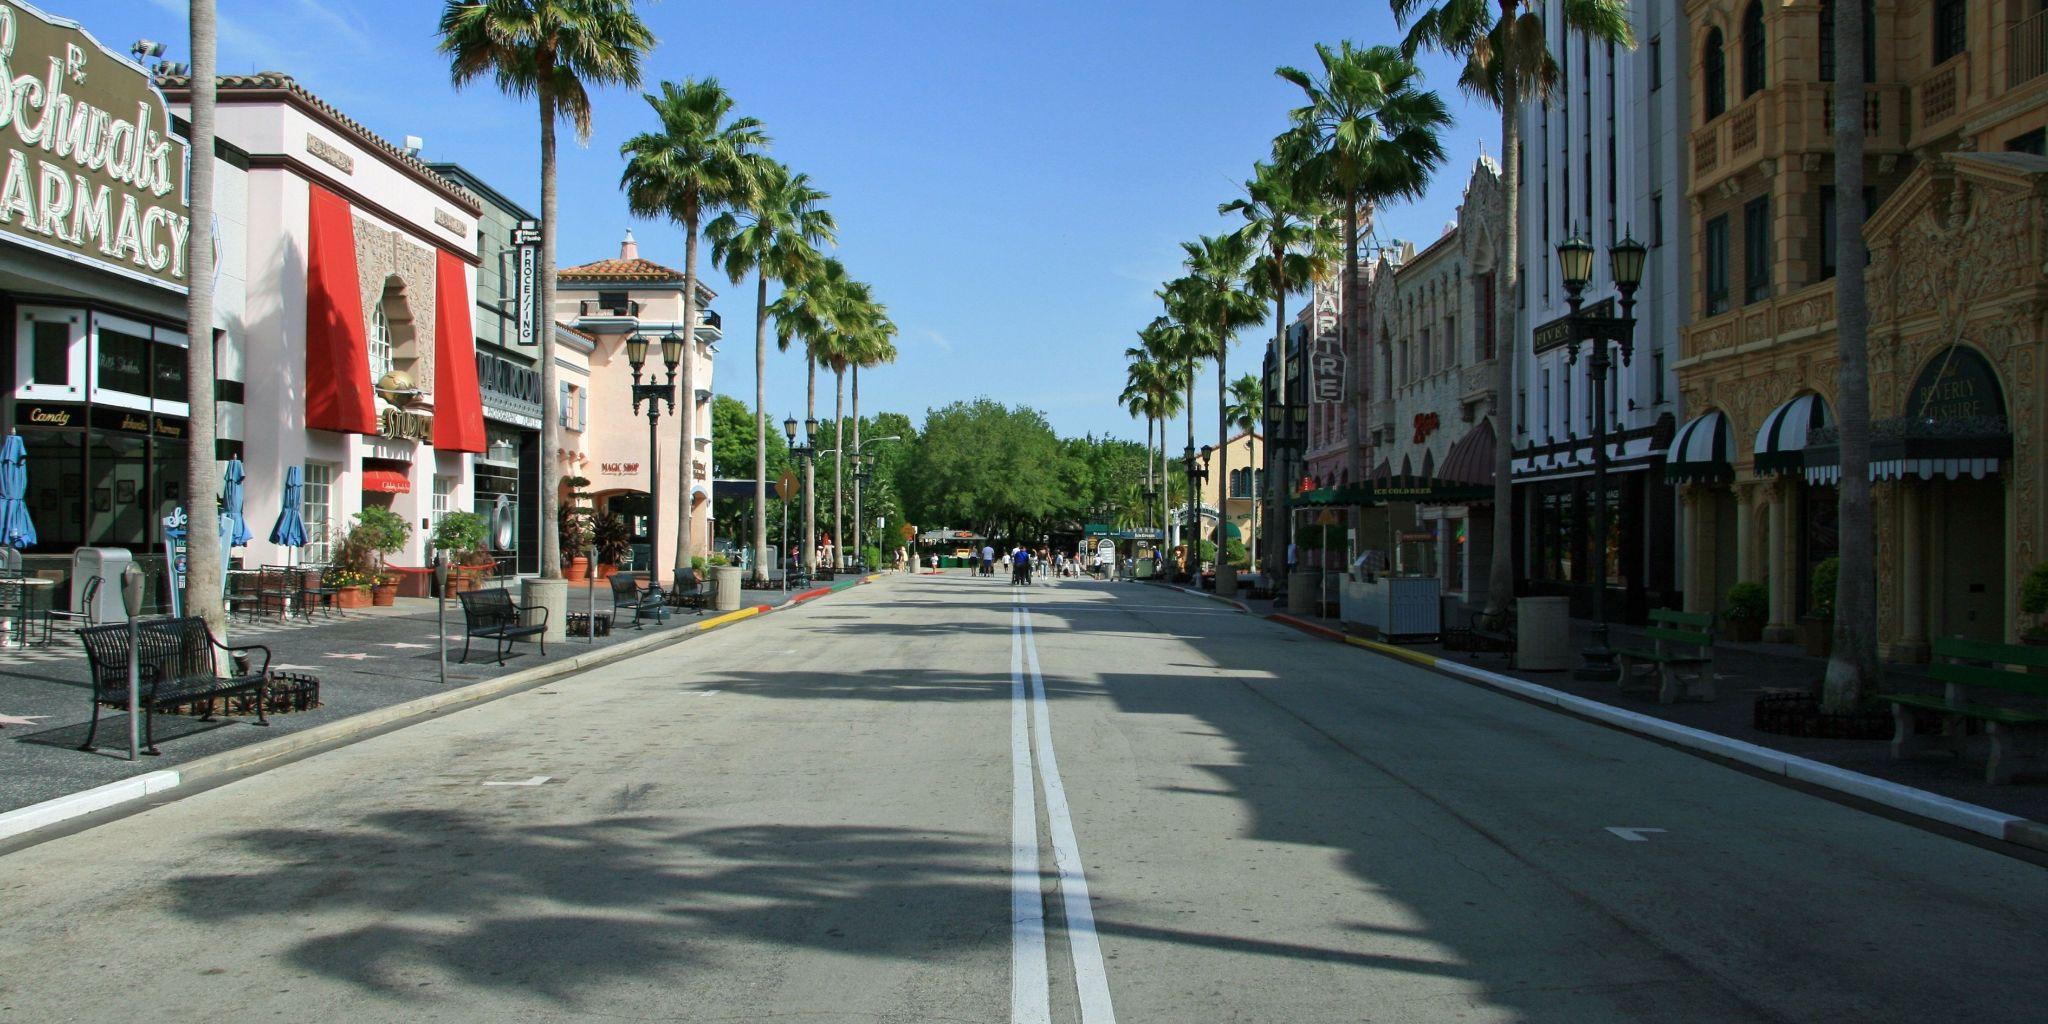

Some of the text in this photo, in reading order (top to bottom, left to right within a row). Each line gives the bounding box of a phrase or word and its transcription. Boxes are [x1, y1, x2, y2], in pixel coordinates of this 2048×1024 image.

[522, 250, 532, 338] PROCESSING
[31, 408, 71, 426] Candy
[601, 463, 622, 472] MAGIC
